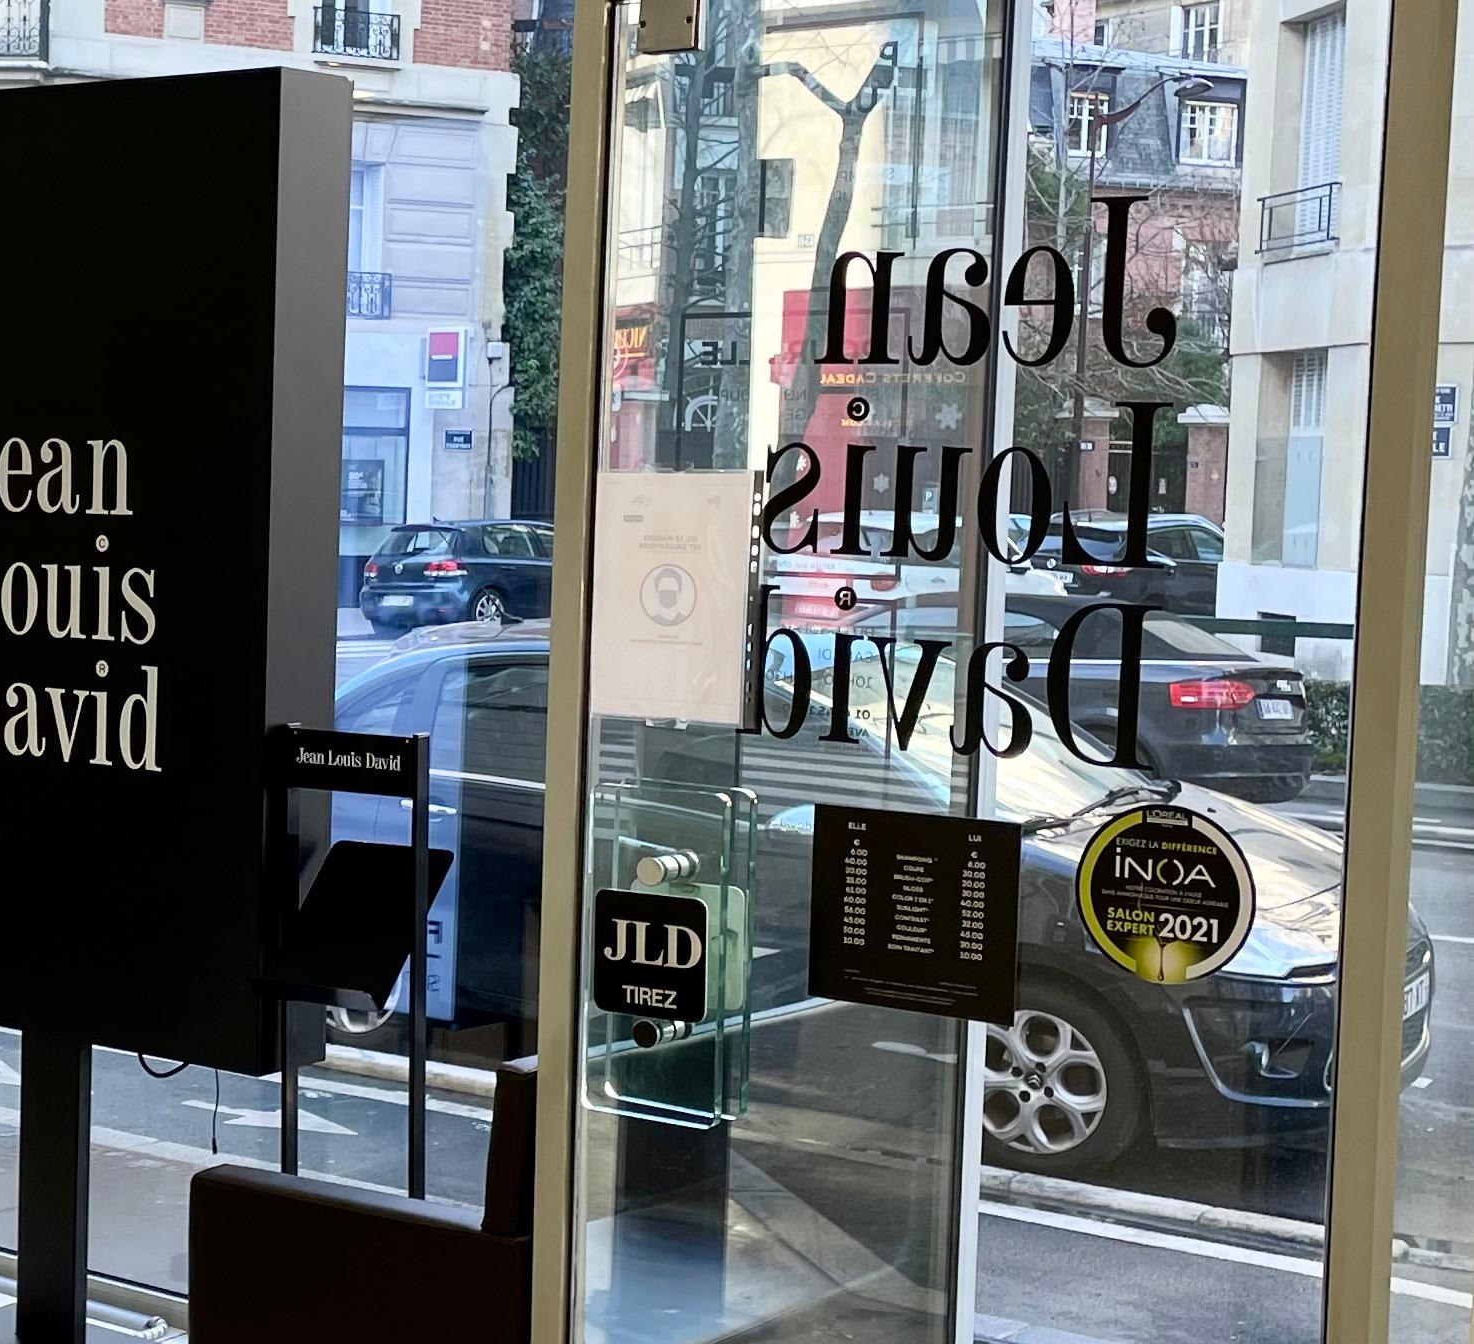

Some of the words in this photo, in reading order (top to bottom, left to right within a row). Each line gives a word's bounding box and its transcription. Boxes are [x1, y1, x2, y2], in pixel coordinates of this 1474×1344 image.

[295, 747, 325, 765] Jean
[327, 749, 362, 767] Louis
[365, 752, 401, 772] David
[1116, 837, 1146, 849] EXIGEZ
[1148, 841, 1159, 849] LA
[1161, 841, 1218, 855] DIFFÉRENCE
[1107, 906, 1155, 923] SALON
[1106, 919, 1155, 937] EXPERT
[1158, 912, 1219, 944] 2021
[603, 918, 702, 969] JLD
[621, 984, 678, 1009] TIREZ
